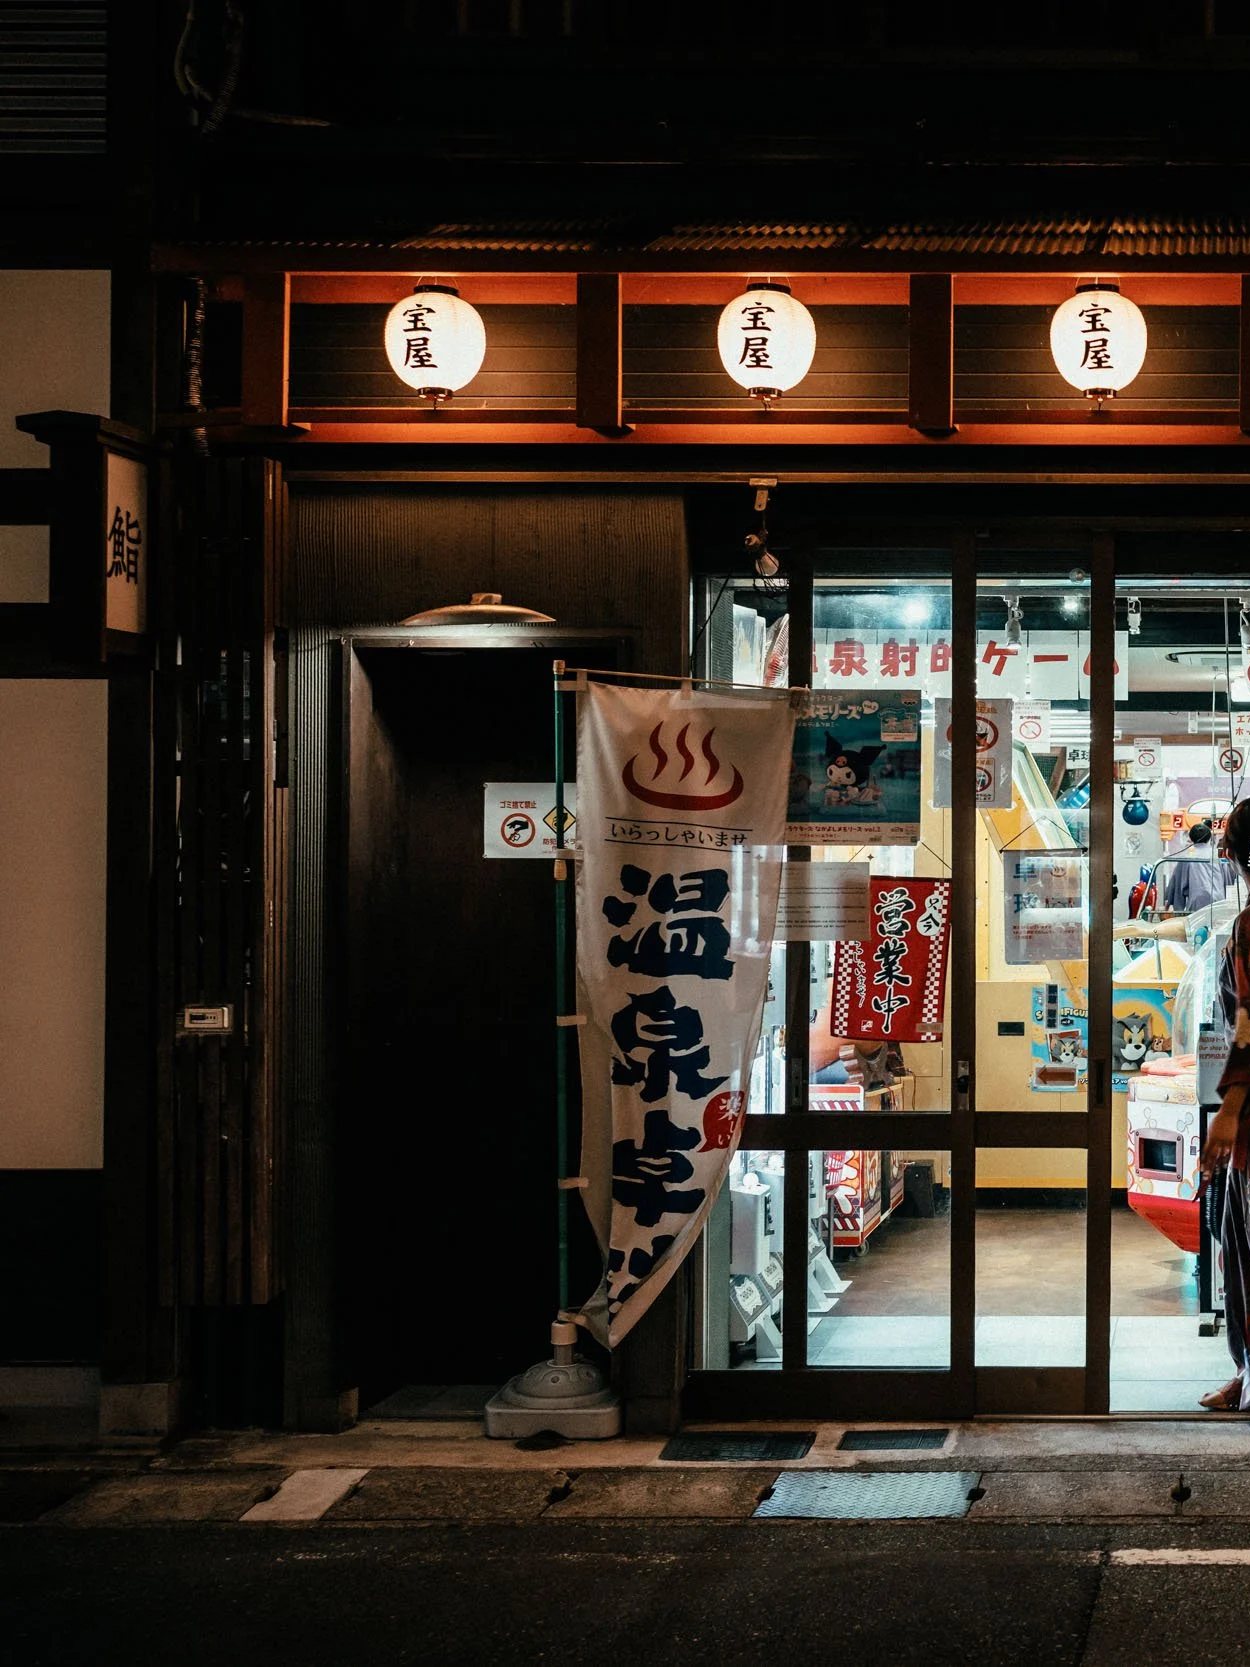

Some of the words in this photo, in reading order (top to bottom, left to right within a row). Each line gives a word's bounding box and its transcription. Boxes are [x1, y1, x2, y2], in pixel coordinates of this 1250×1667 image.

[402, 303, 438, 369] 宝屋
[739, 302, 775, 369] 宝屋
[1078, 303, 1114, 370] 宝屋
[107, 506, 142, 584] 鮨
[500, 801, 537, 809] ゴミ捨て禁止
[611, 823, 748, 847] いらっしゃいませ
[1173, 818, 1182, 828] 2
[919, 897, 941, 934] 只今
[872, 887, 917, 1034] 営業中
